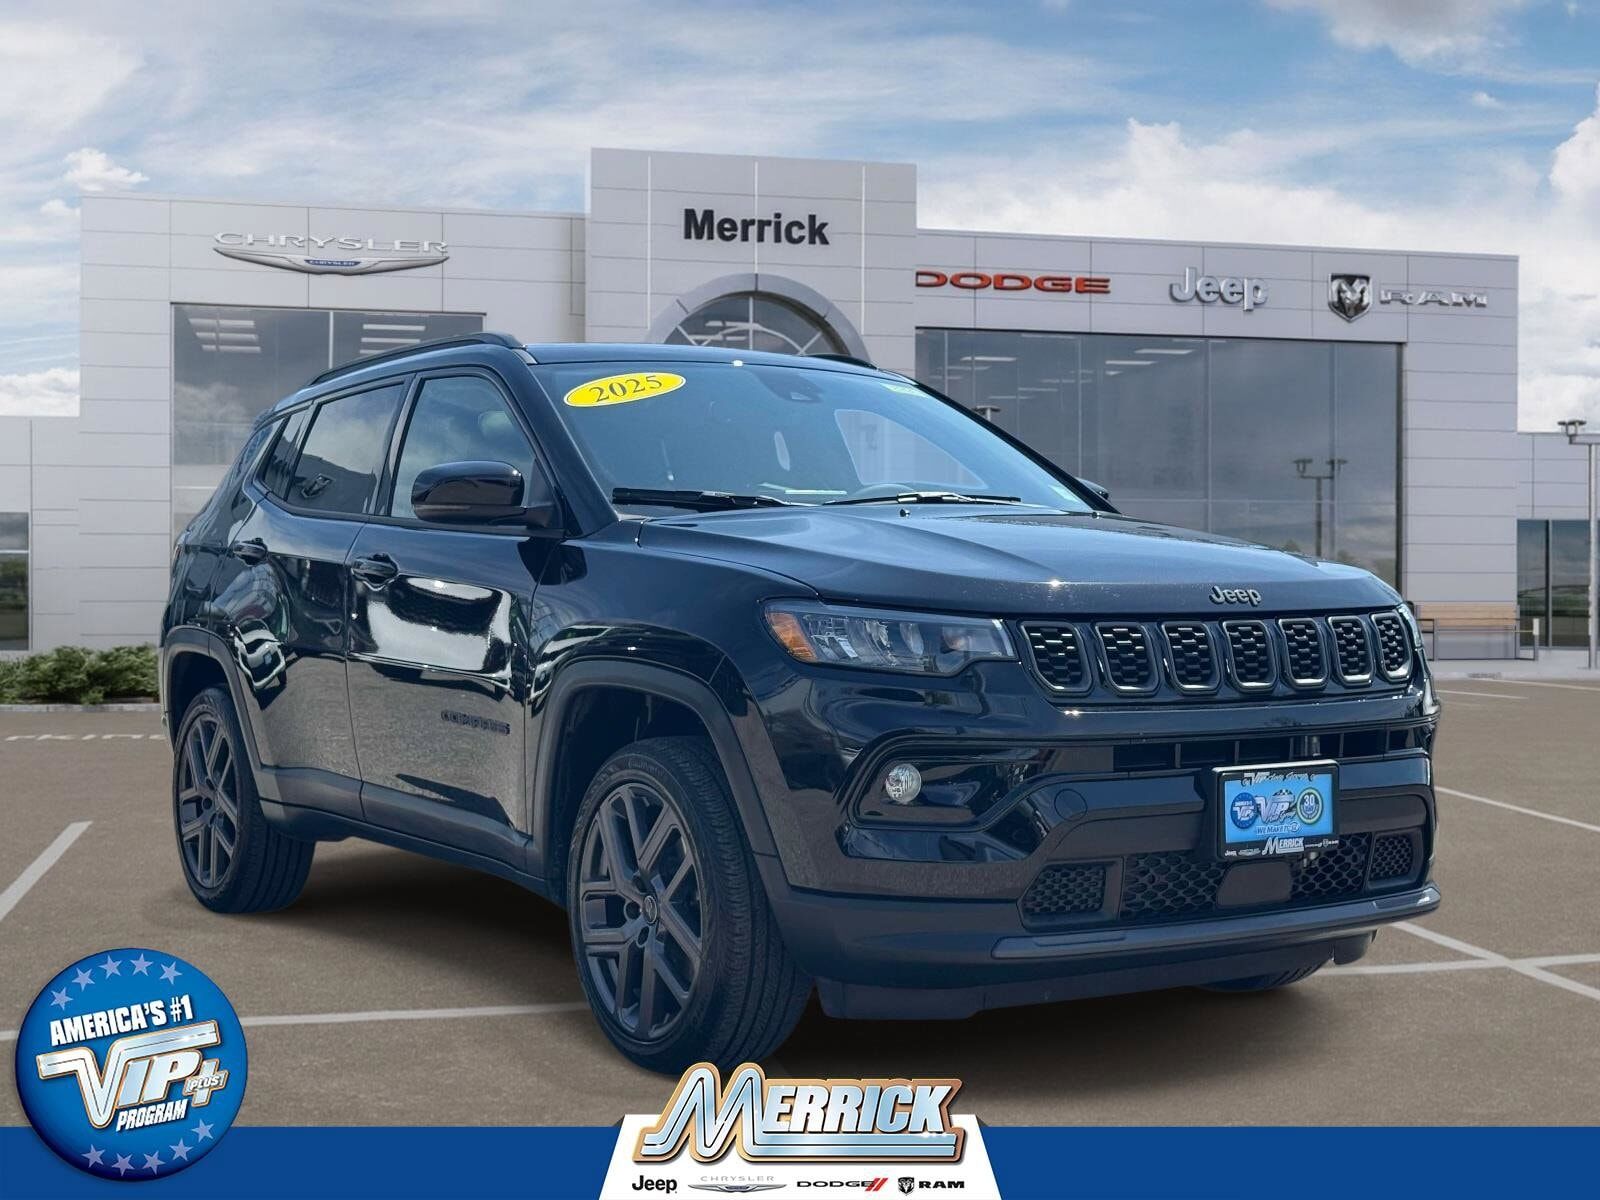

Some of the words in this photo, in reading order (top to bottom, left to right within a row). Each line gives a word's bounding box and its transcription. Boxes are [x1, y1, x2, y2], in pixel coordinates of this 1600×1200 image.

[683, 208, 830, 245] Merrick
[214, 231, 449, 254] CHRYSLER
[915, 271, 1111, 294] DODGE
[1169, 266, 1269, 312] Jeep
[1380, 289, 1488, 308] RAM
[589, 375, 663, 403] 2025
[1208, 585, 1262, 607] Jeep
[1254, 795, 1294, 823] VIP
[1303, 794, 1316, 807] 30
[1262, 836, 1304, 856] MERRICK
